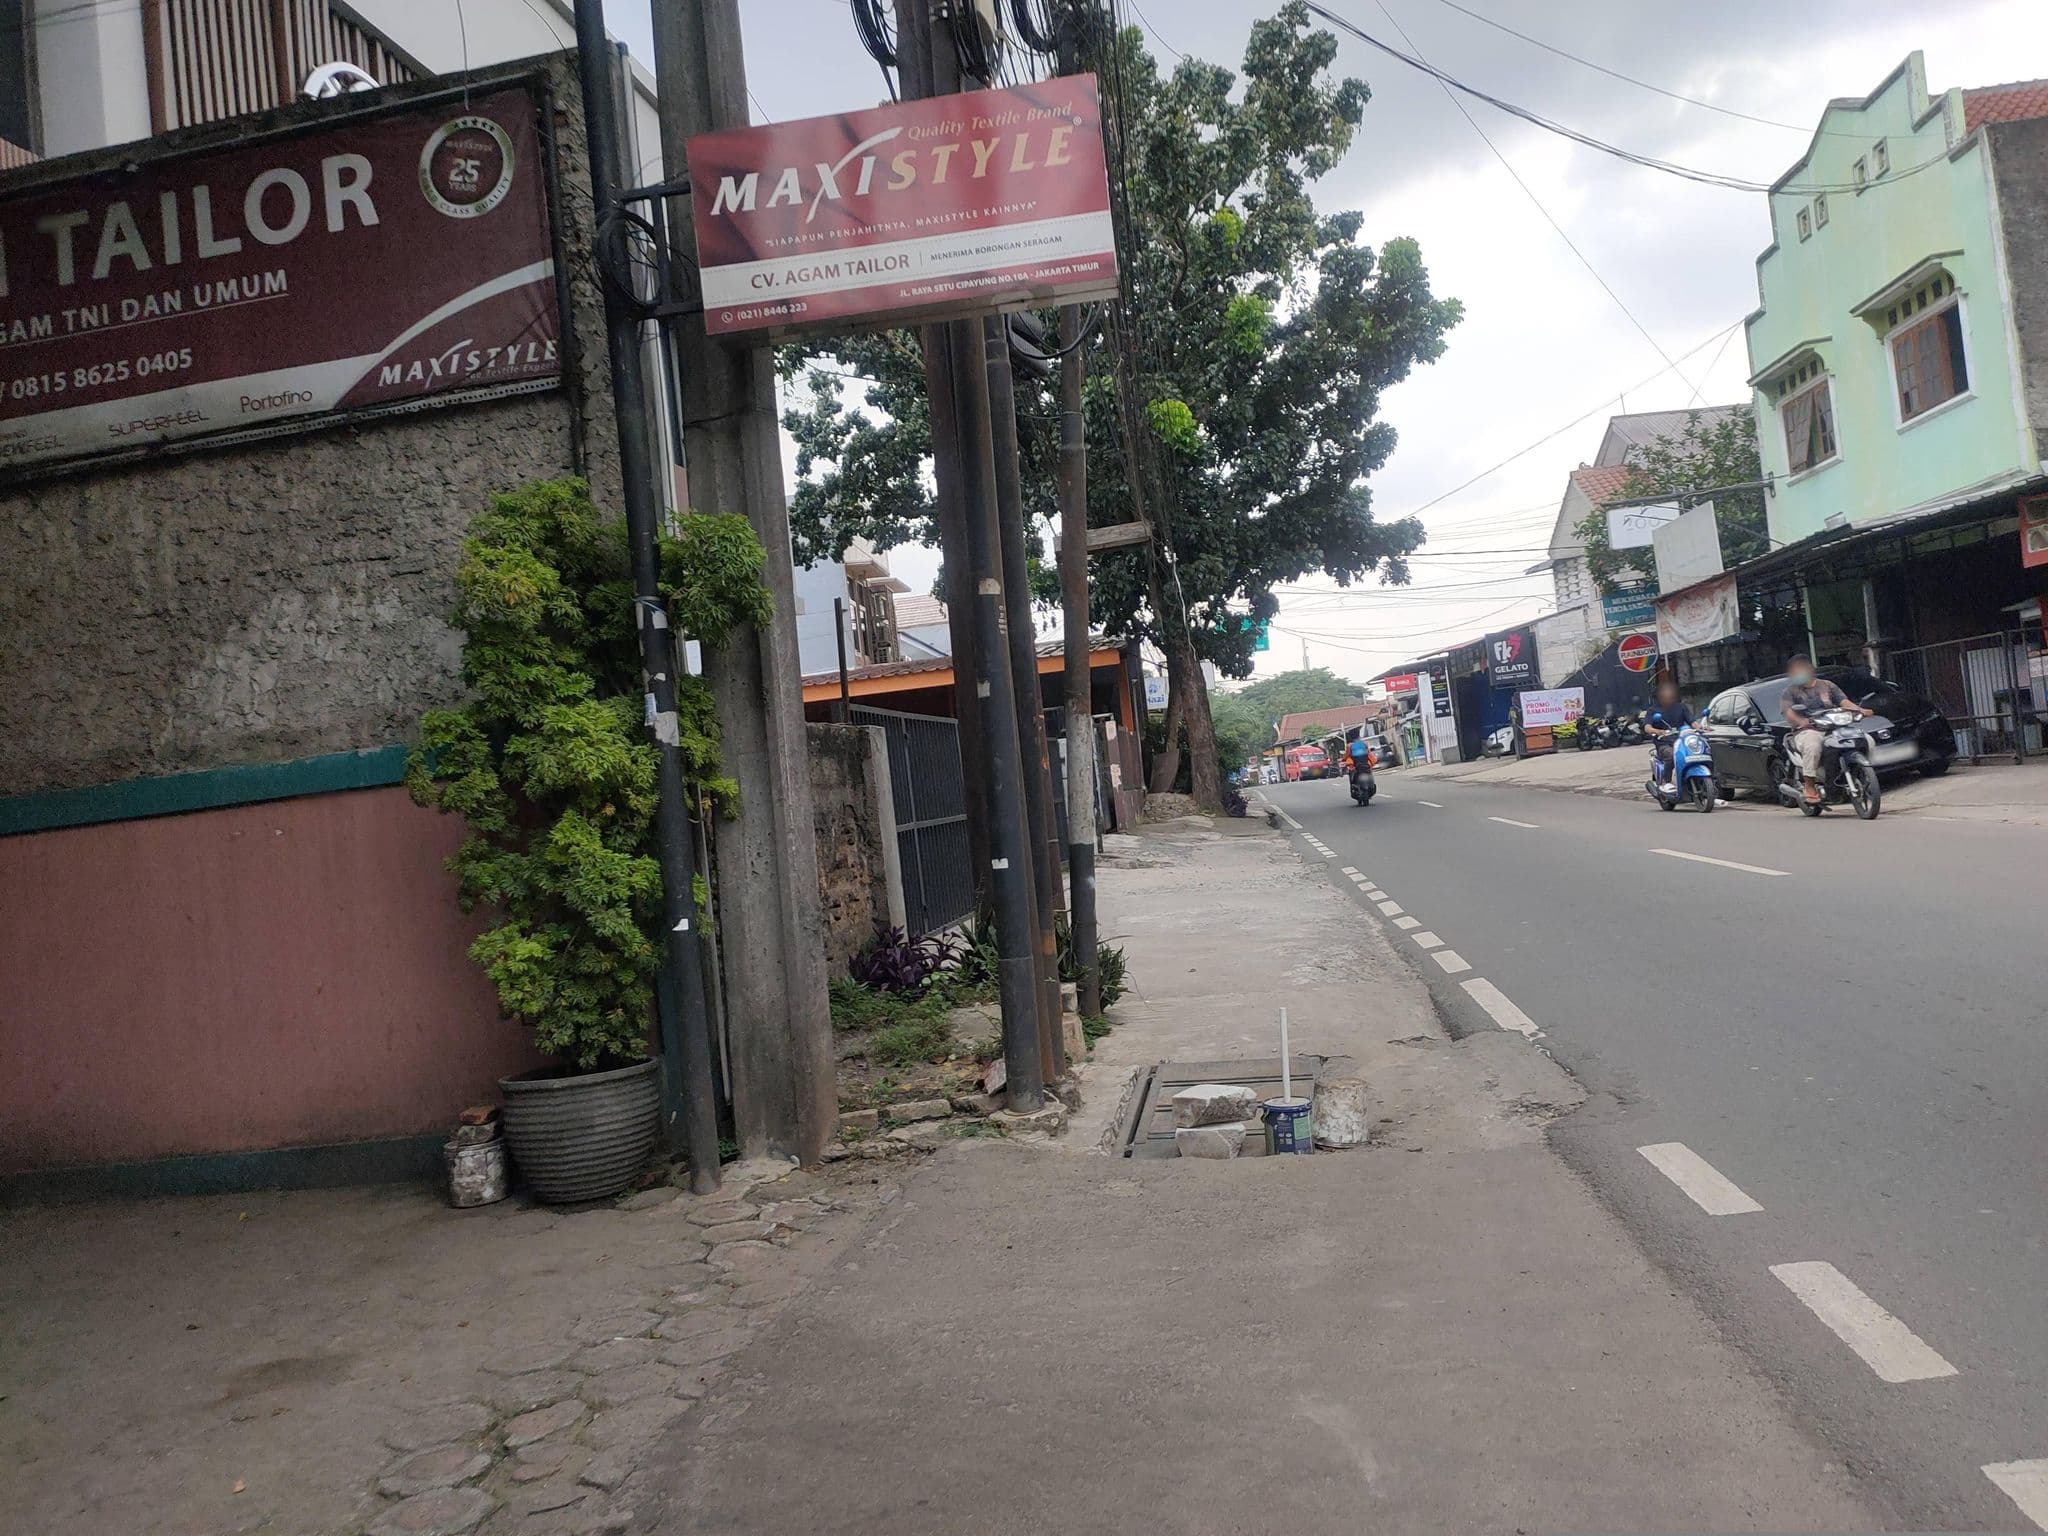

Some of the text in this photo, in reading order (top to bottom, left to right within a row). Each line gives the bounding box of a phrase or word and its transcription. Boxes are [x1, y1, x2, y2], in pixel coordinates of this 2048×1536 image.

[908, 100, 1074, 141] Quality Textile Brand
[448, 157, 481, 184] 25
[710, 122, 1076, 224] MAXISTYLE
[36, 152, 380, 286] TAILOR
[915, 209, 979, 228] MAXISTYLE
[930, 235, 1062, 262] MENERIMA BORONGAN SERAGAM
[751, 254, 909, 289] CV. AGAM TAILOR
[899, 289, 911, 298] JL.
[911, 287, 934, 297] RAYA
[933, 283, 955, 293] SETU
[956, 276, 997, 290] CIPAYUNG
[1034, 265, 1072, 279] JAKARTA
[1071, 262, 1100, 273] TIMUR
[62, 303, 110, 332] TNI
[121, 288, 182, 321] DAN
[194, 268, 288, 308] UMUM
[737, 308, 762, 321] (021)
[763, 304, 788, 317] 8446
[11, 371, 68, 400] 0815
[73, 358, 131, 390] 8625
[135, 347, 194, 378] 0405
[239, 388, 314, 415] Portofino
[108, 410, 210, 438] SUPERFEEL
[1494, 663, 1529, 674] GELATO
